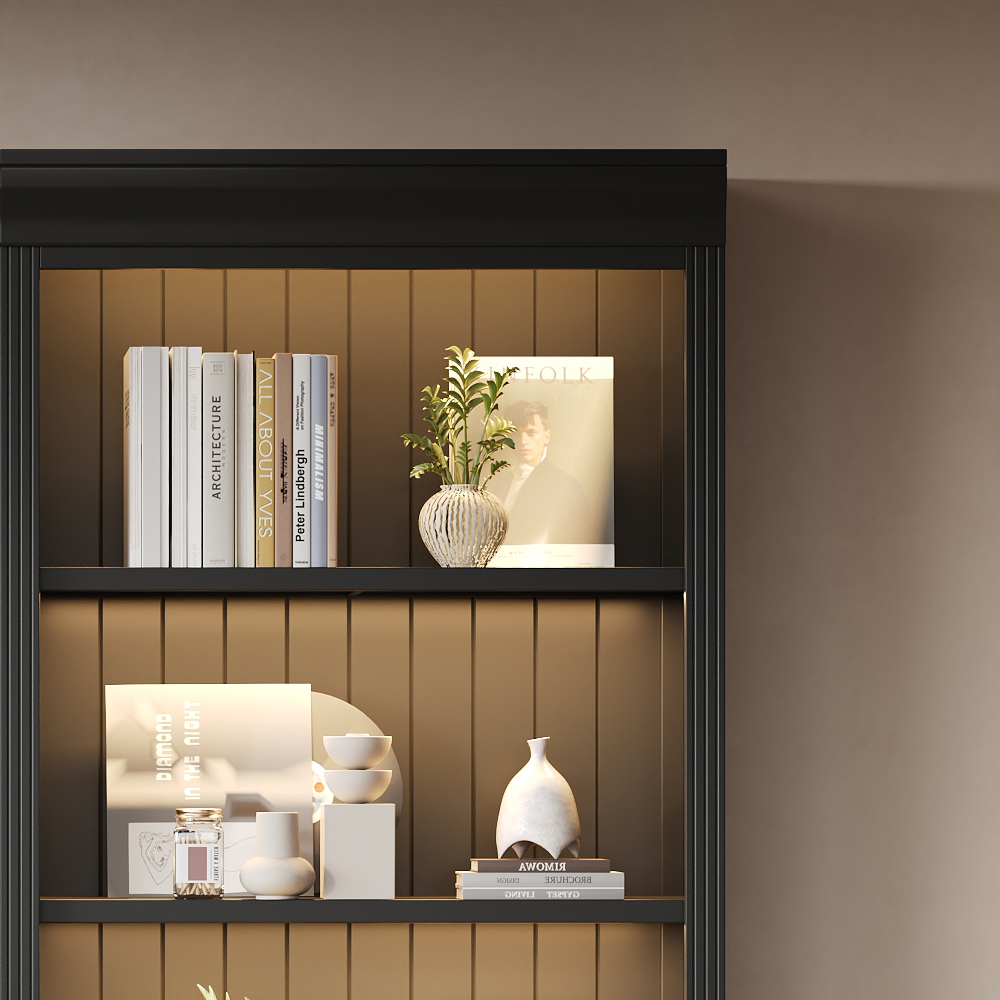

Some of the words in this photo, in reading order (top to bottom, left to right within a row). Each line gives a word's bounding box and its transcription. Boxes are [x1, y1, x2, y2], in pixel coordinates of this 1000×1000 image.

[258, 369, 272, 404] ALL
[212, 395, 221, 499] ARCHITECTURE
[258, 411, 272, 481] ABOUT
[314, 424, 324, 501] MINIMALISM
[295, 449, 308, 509] Lindbergh
[258, 490, 272, 538] YVES
[295, 512, 305, 542] Peter
[156, 713, 172, 781] DIAMOND
[184, 701, 200, 746] NIGHT
[184, 755, 200, 781] THE
[184, 788, 200, 800] IN
